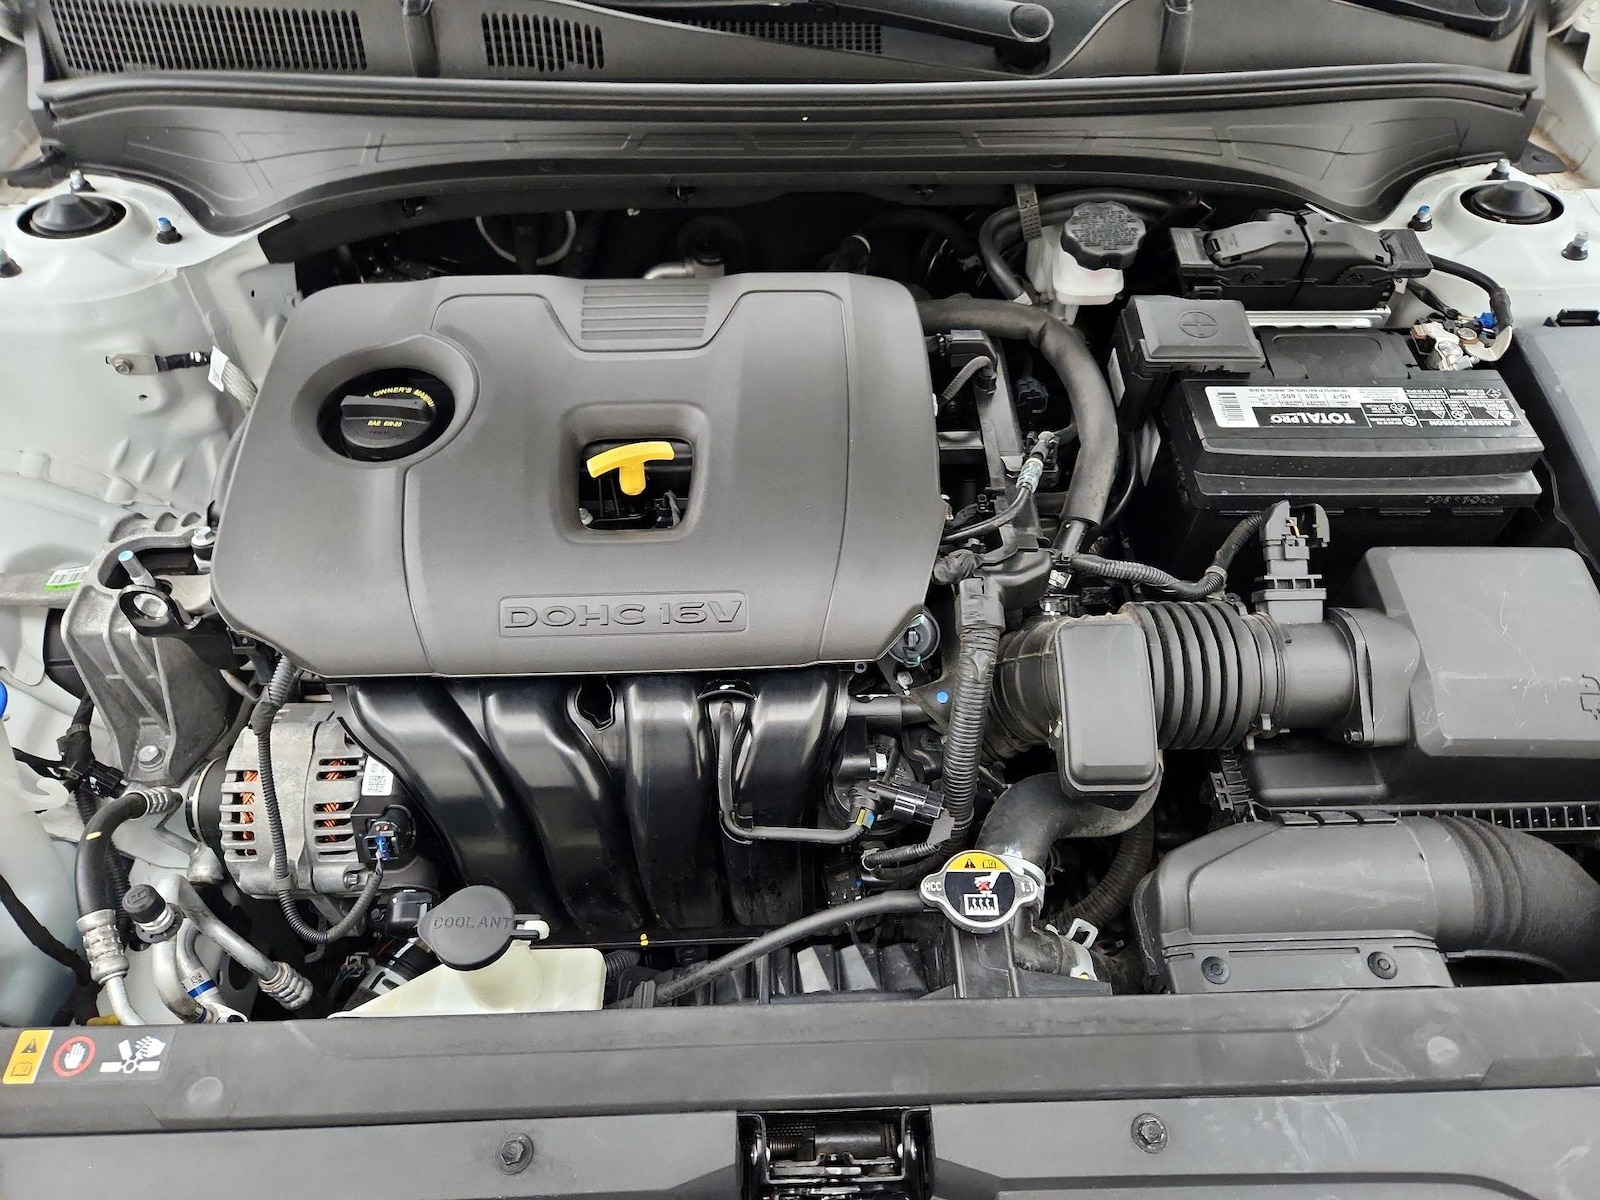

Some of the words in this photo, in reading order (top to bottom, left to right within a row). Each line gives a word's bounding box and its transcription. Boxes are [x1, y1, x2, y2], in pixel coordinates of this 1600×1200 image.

[373, 387, 412, 397] OWNER'S
[1271, 412, 1356, 425] TOTALPRO
[504, 603, 646, 629] DOHC
[659, 600, 743, 625] 16V
[924, 881, 943, 892] HCC
[433, 915, 512, 930] COOLANT
